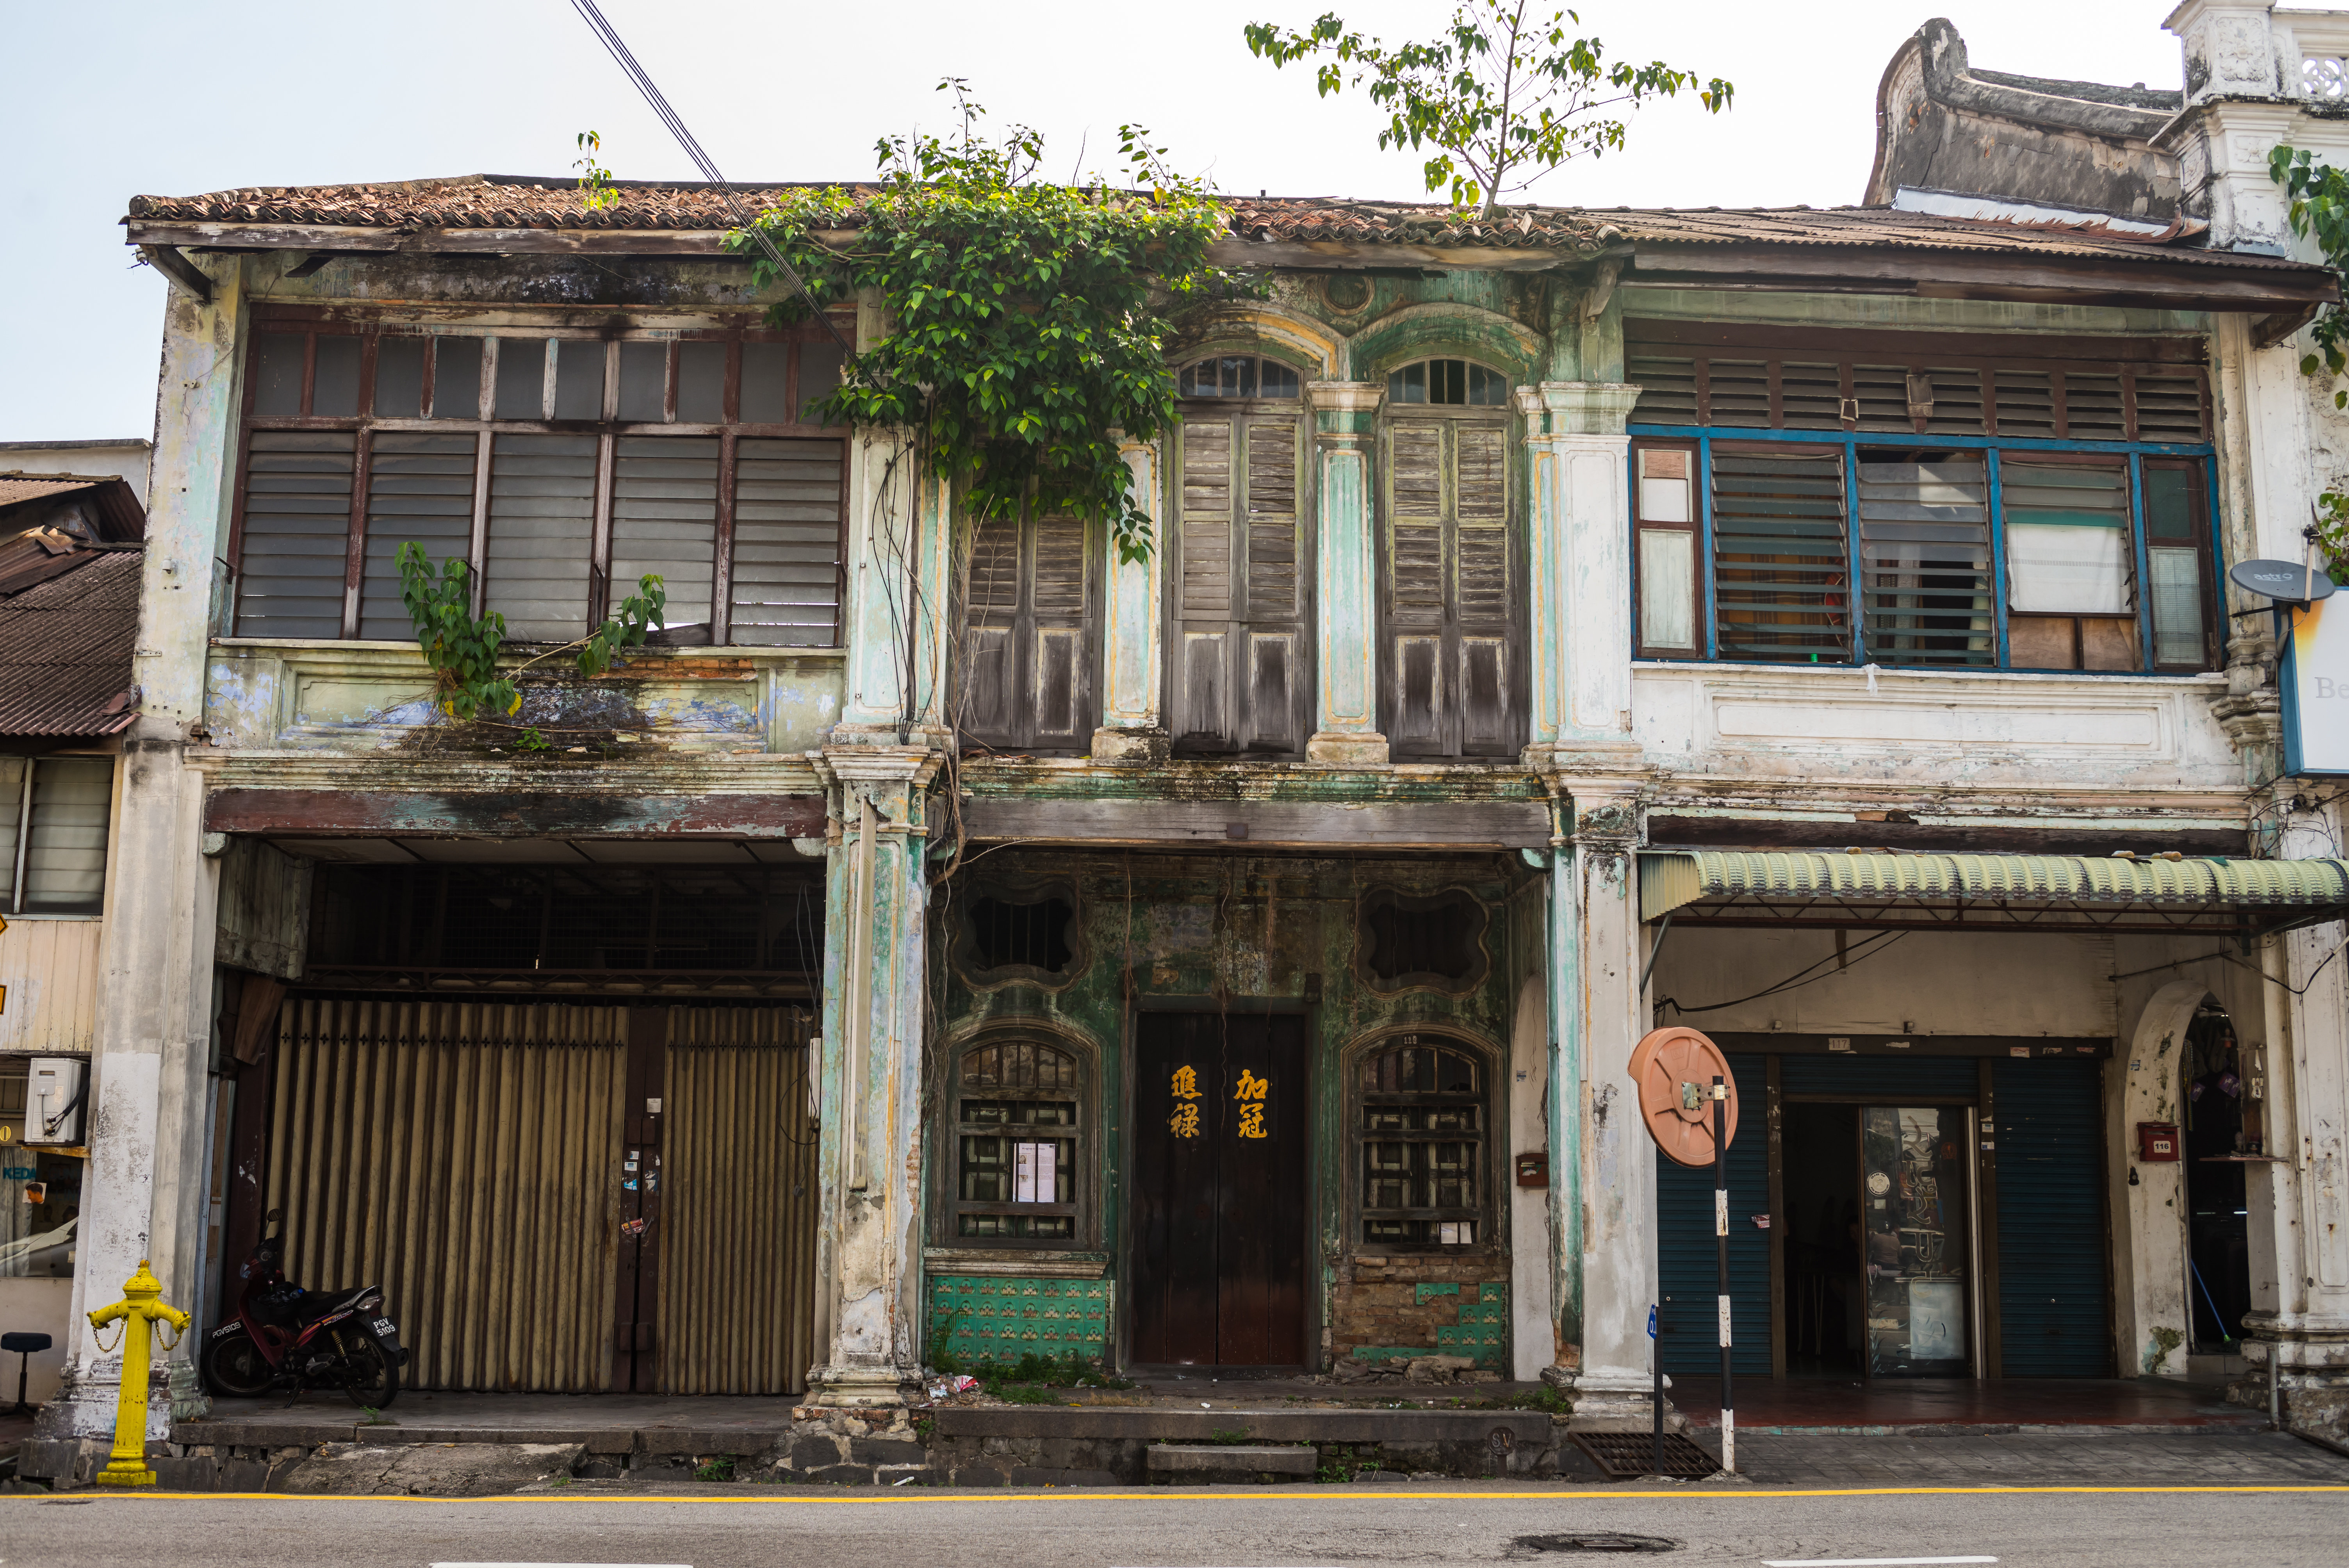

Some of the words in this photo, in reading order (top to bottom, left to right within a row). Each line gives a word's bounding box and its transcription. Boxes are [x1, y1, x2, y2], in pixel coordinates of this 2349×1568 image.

[1832, 1039, 1847, 1048] 117
[1233, 1069, 1269, 1138] 加冠
[373, 1317, 389, 1329] PGV
[212, 1322, 241, 1338] PGV5109
[376, 1324, 396, 1336] 5109
